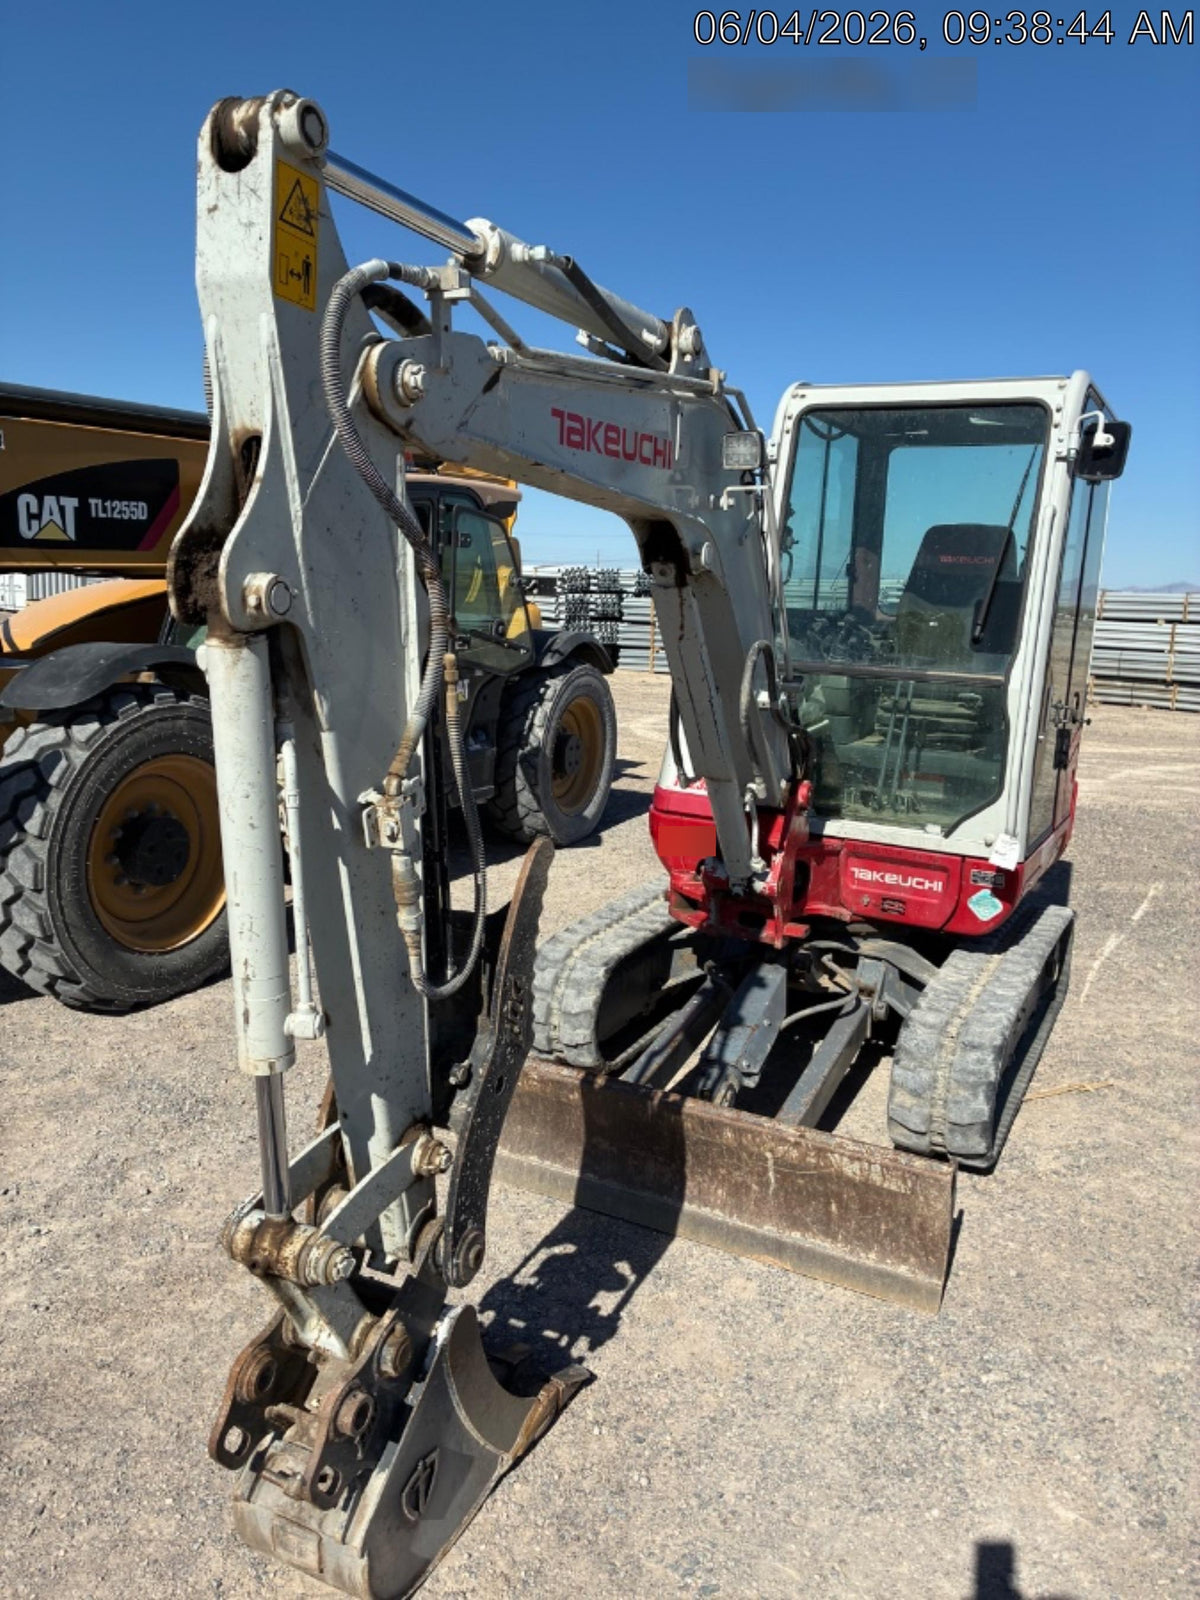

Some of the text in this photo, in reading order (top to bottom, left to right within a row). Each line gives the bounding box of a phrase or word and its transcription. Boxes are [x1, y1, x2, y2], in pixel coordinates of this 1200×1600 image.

[551, 407, 673, 470] TAKEUCHI
[17, 493, 148, 541] CAT TL1255D
[850, 867, 943, 892] TAKEUCHI
